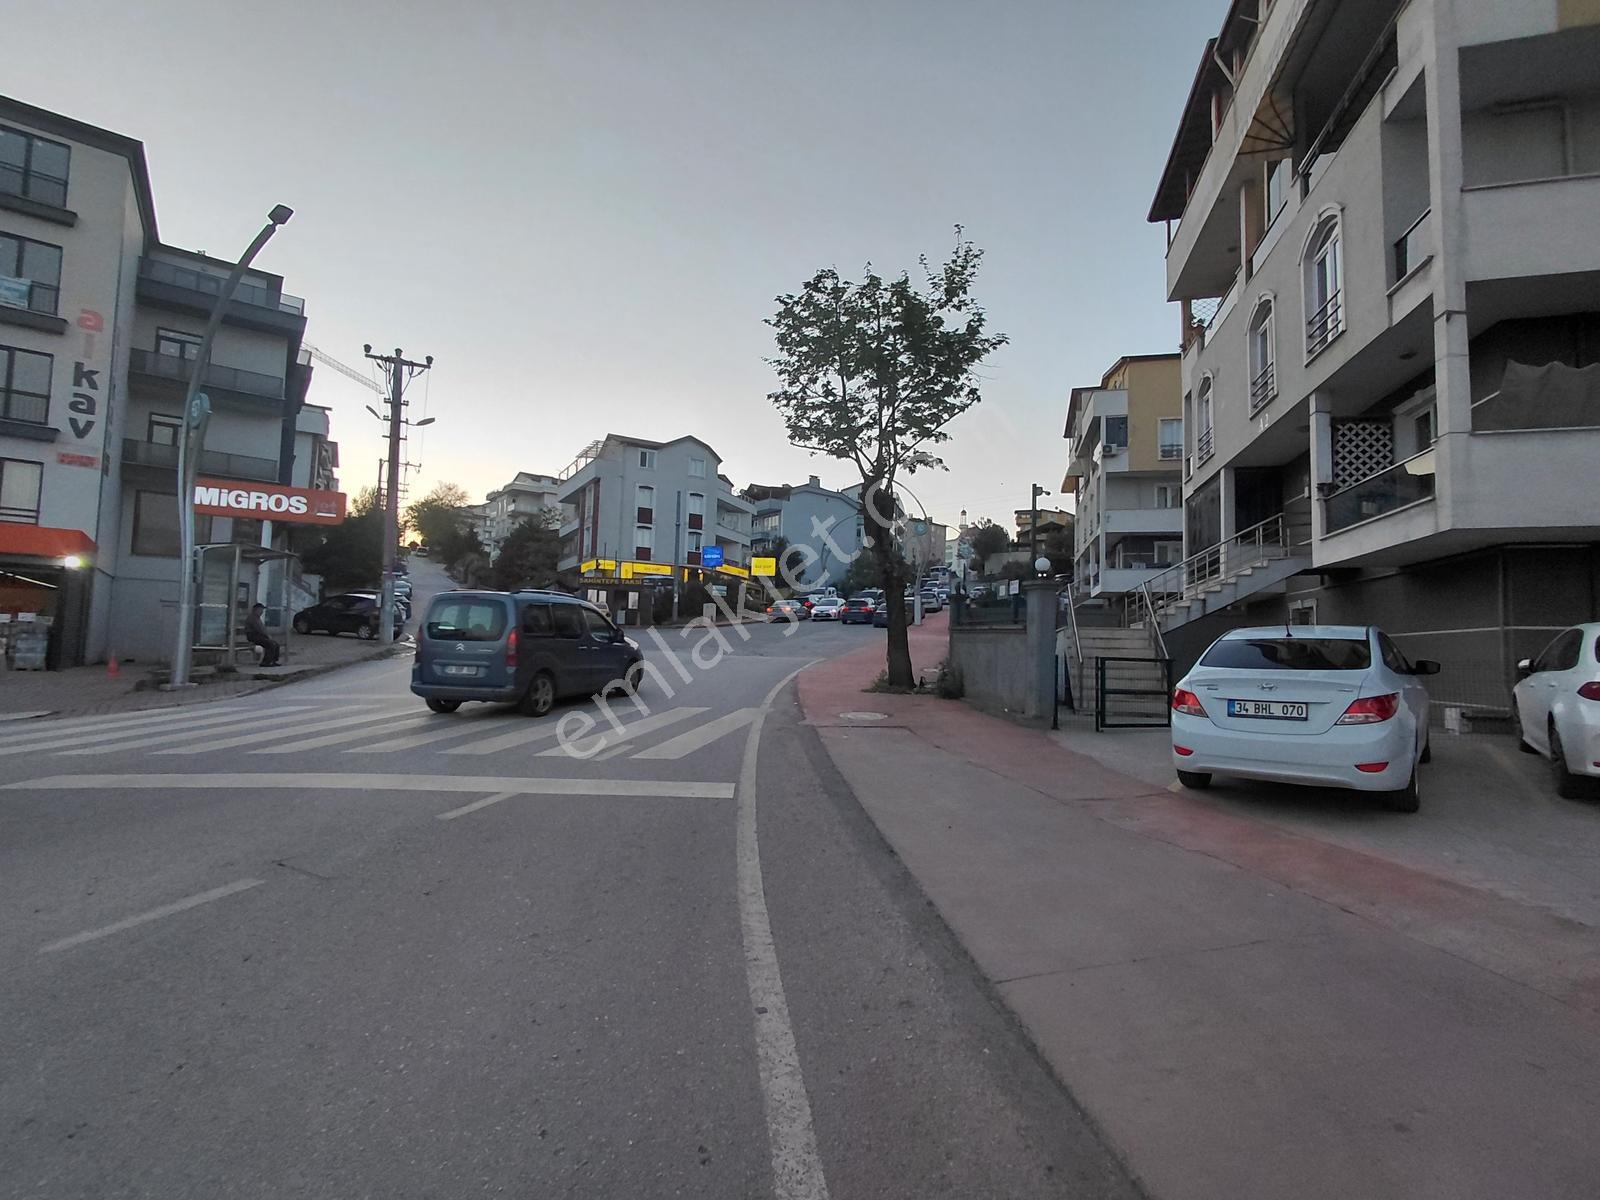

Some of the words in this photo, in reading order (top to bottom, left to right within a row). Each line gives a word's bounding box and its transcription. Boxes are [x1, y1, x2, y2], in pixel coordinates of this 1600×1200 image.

[1236, 703, 1249, 713] 34
[1254, 703, 1274, 715] BHL
[1282, 705, 1304, 716] 070
